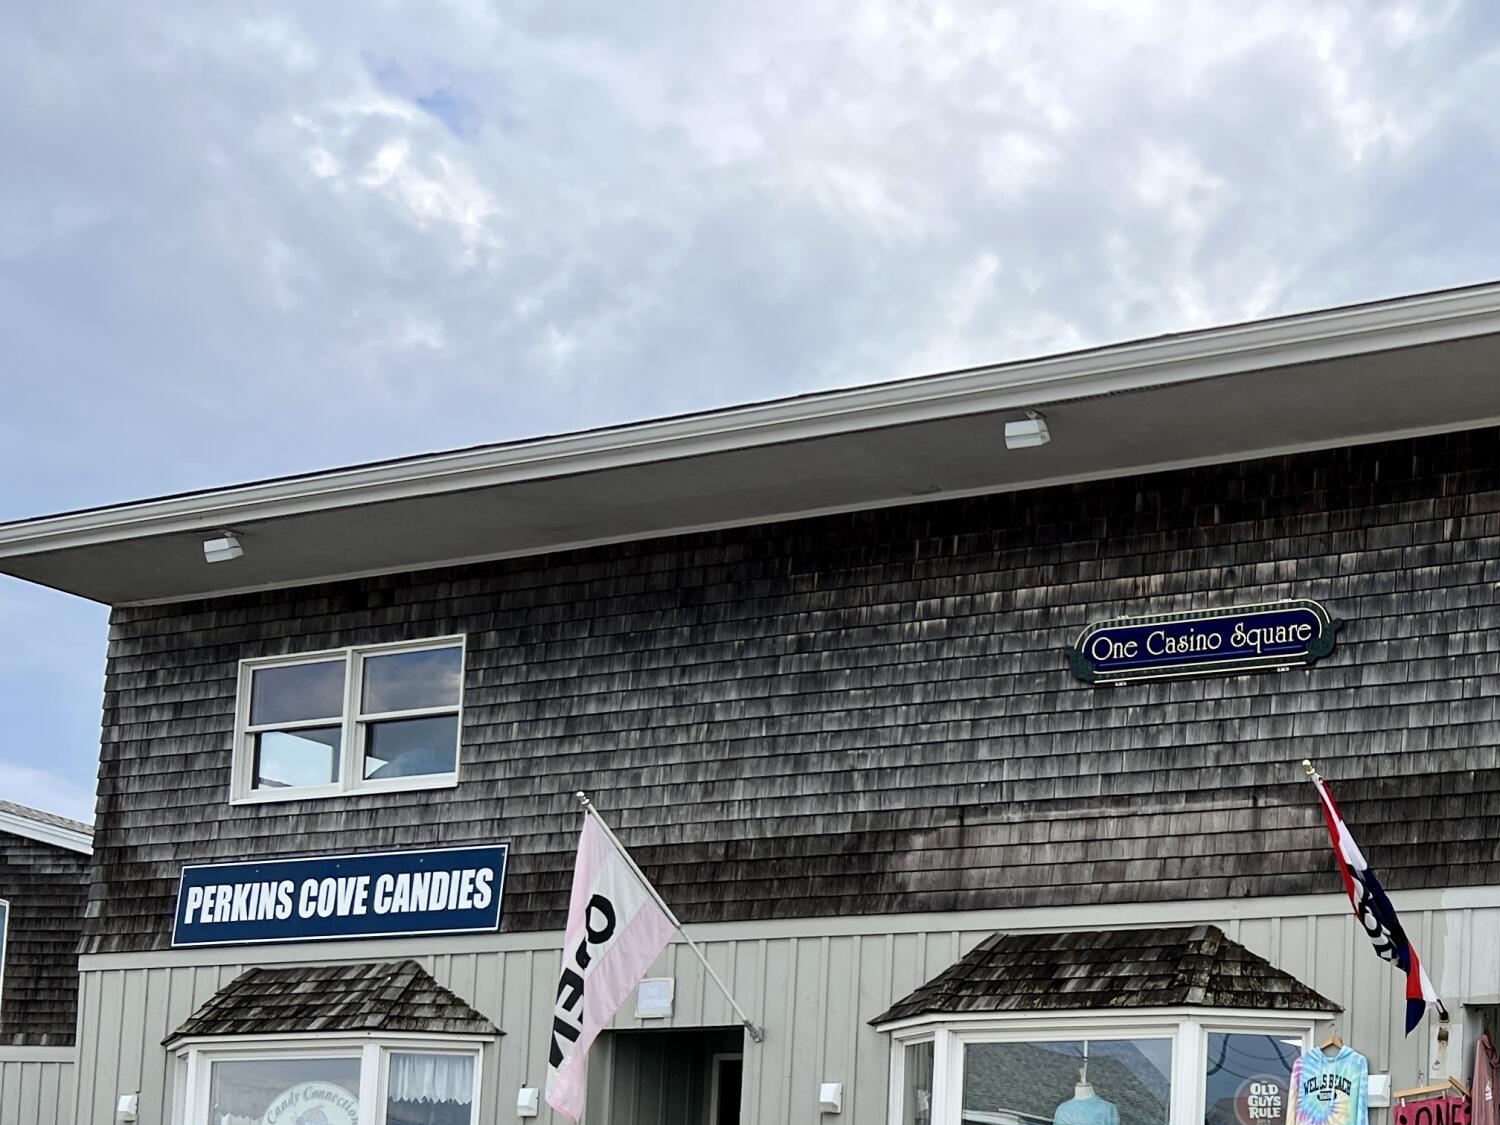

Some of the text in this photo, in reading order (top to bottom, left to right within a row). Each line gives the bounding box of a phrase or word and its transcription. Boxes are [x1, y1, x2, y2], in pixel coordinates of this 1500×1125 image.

[1091, 622, 1312, 661] One Casino Square
[184, 867, 494, 924] PERKINS COVE CANDIES
[1250, 1082, 1279, 1095] OLD
[1247, 1095, 1281, 1107] GUYS
[1248, 1106, 1281, 1119] RULE
